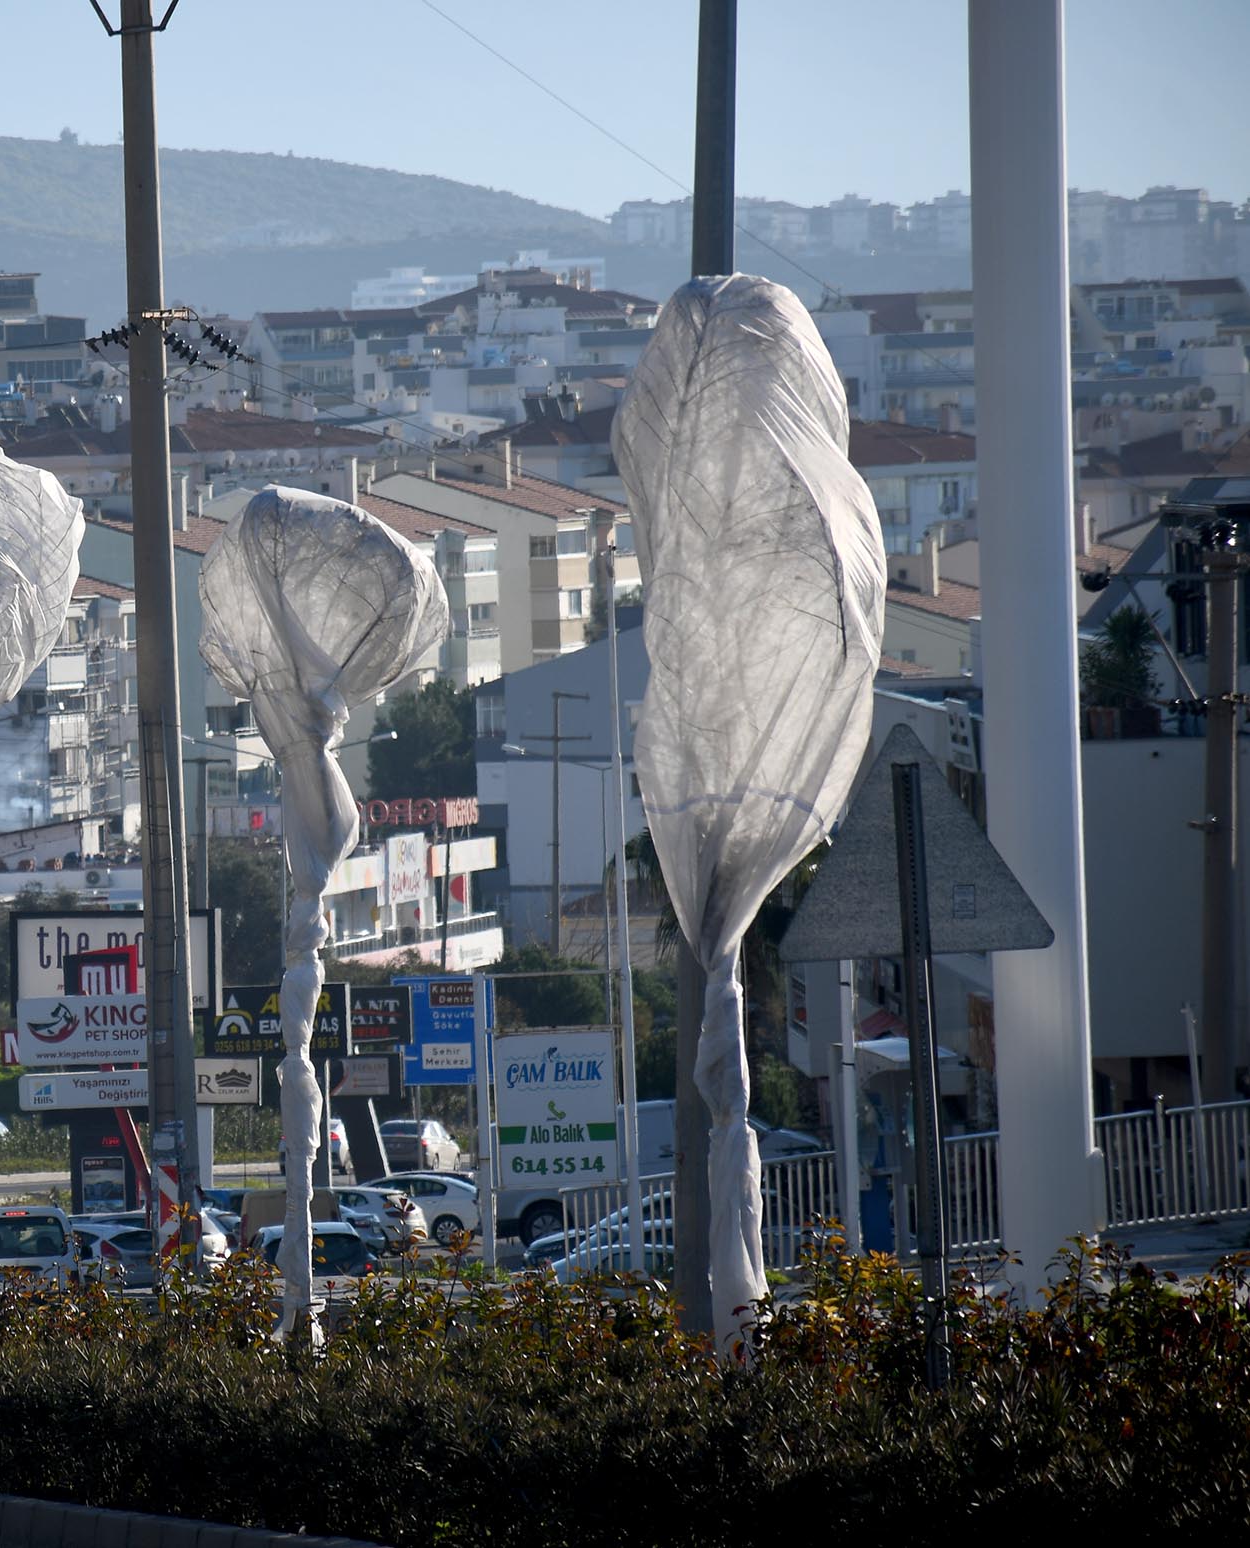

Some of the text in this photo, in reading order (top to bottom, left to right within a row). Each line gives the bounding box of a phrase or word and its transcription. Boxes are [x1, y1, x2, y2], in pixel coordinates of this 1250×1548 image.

[37, 926, 89, 969] the
[432, 985, 473, 993] Kadınla
[84, 1004, 147, 1026] KING
[432, 1011, 474, 1020] Davutla
[85, 1028, 147, 1041] PET SHOP
[36, 1049, 139, 1060] www.kingpetshop.com.tr
[425, 1058, 469, 1067] Merkezi
[506, 1060, 604, 1088] ÇAM BALIK
[72, 1078, 130, 1090] Yaşamınızı
[530, 1123, 585, 1144] Alo Balık
[512, 1155, 605, 1175] 614 55 14
